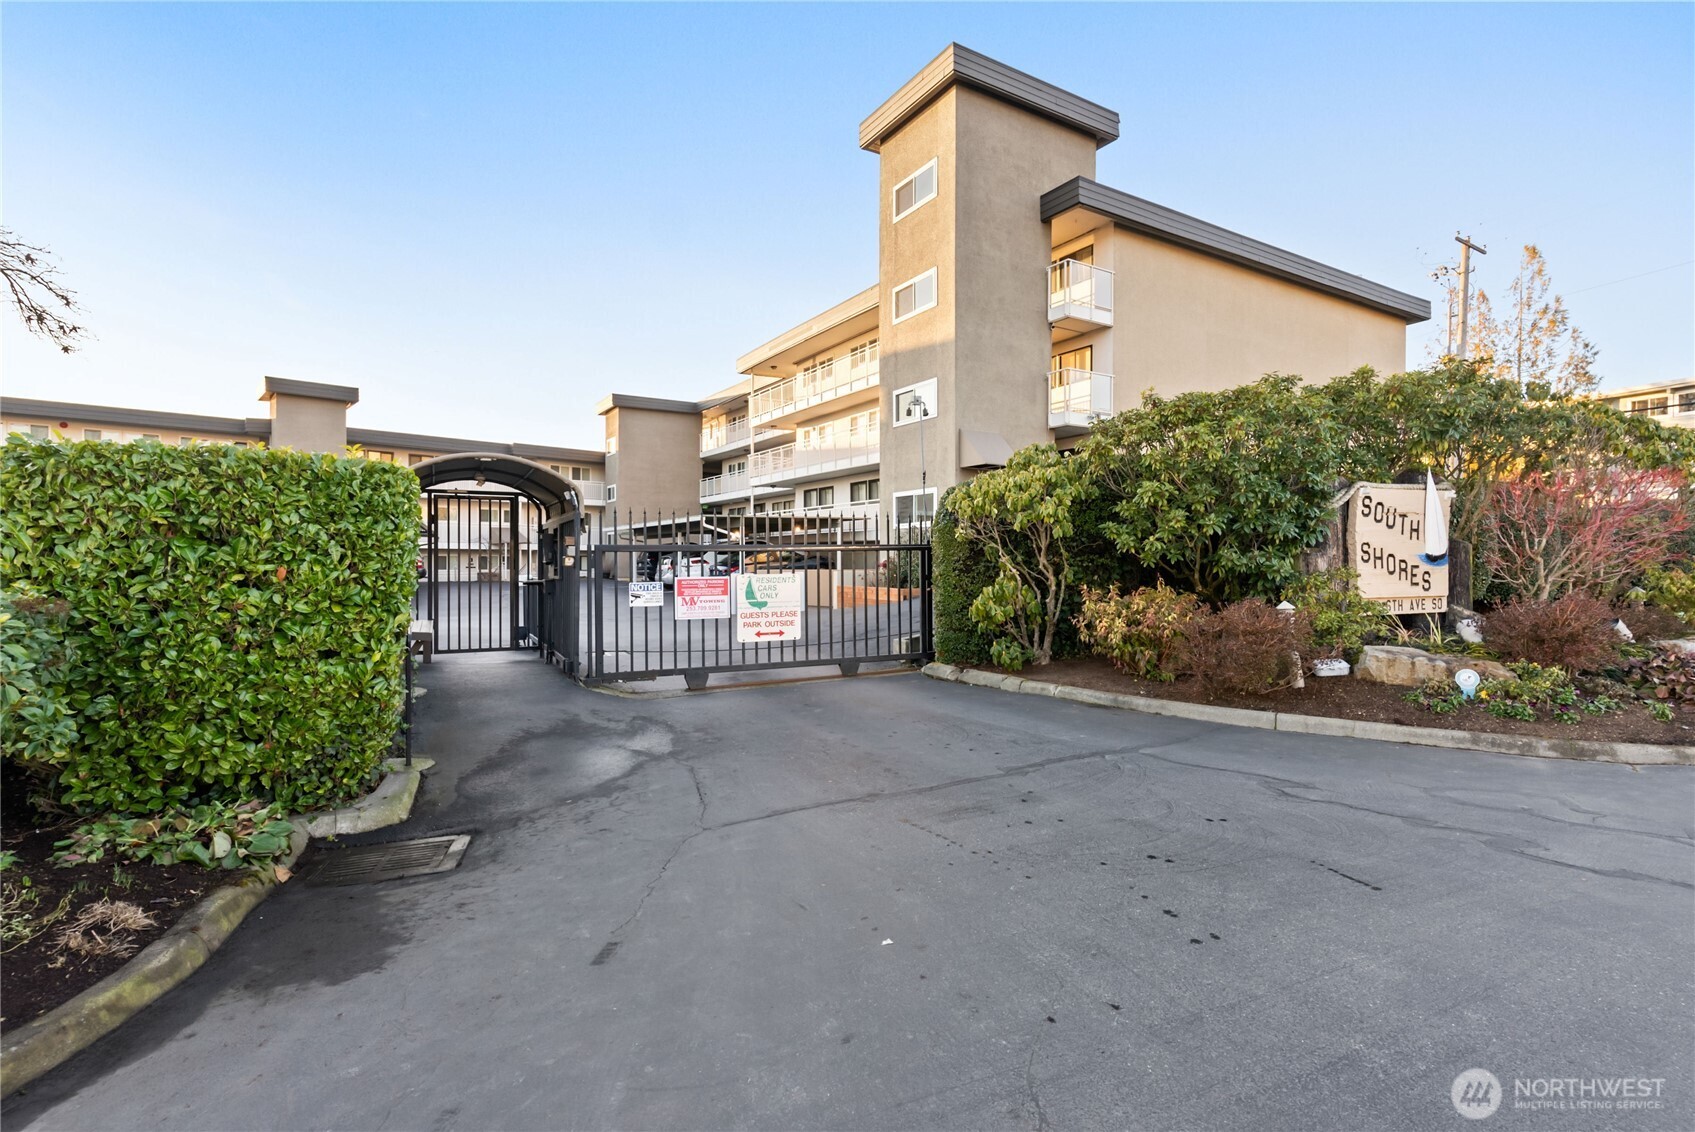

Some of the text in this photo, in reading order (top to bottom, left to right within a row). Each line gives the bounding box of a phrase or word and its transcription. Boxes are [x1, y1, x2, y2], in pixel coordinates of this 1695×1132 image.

[1361, 495, 1420, 540] SOUTH
[1360, 542, 1432, 592] SHORES
[756, 576, 796, 584] RESIDENTS
[631, 583, 662, 591] NOTICE
[757, 584, 777, 592] CARS
[1409, 598, 1426, 611] AVE
[1431, 597, 1443, 610] SO
[740, 610, 799, 619] GUESTS PLEASE
[764, 619, 796, 628] OUTSIDE
